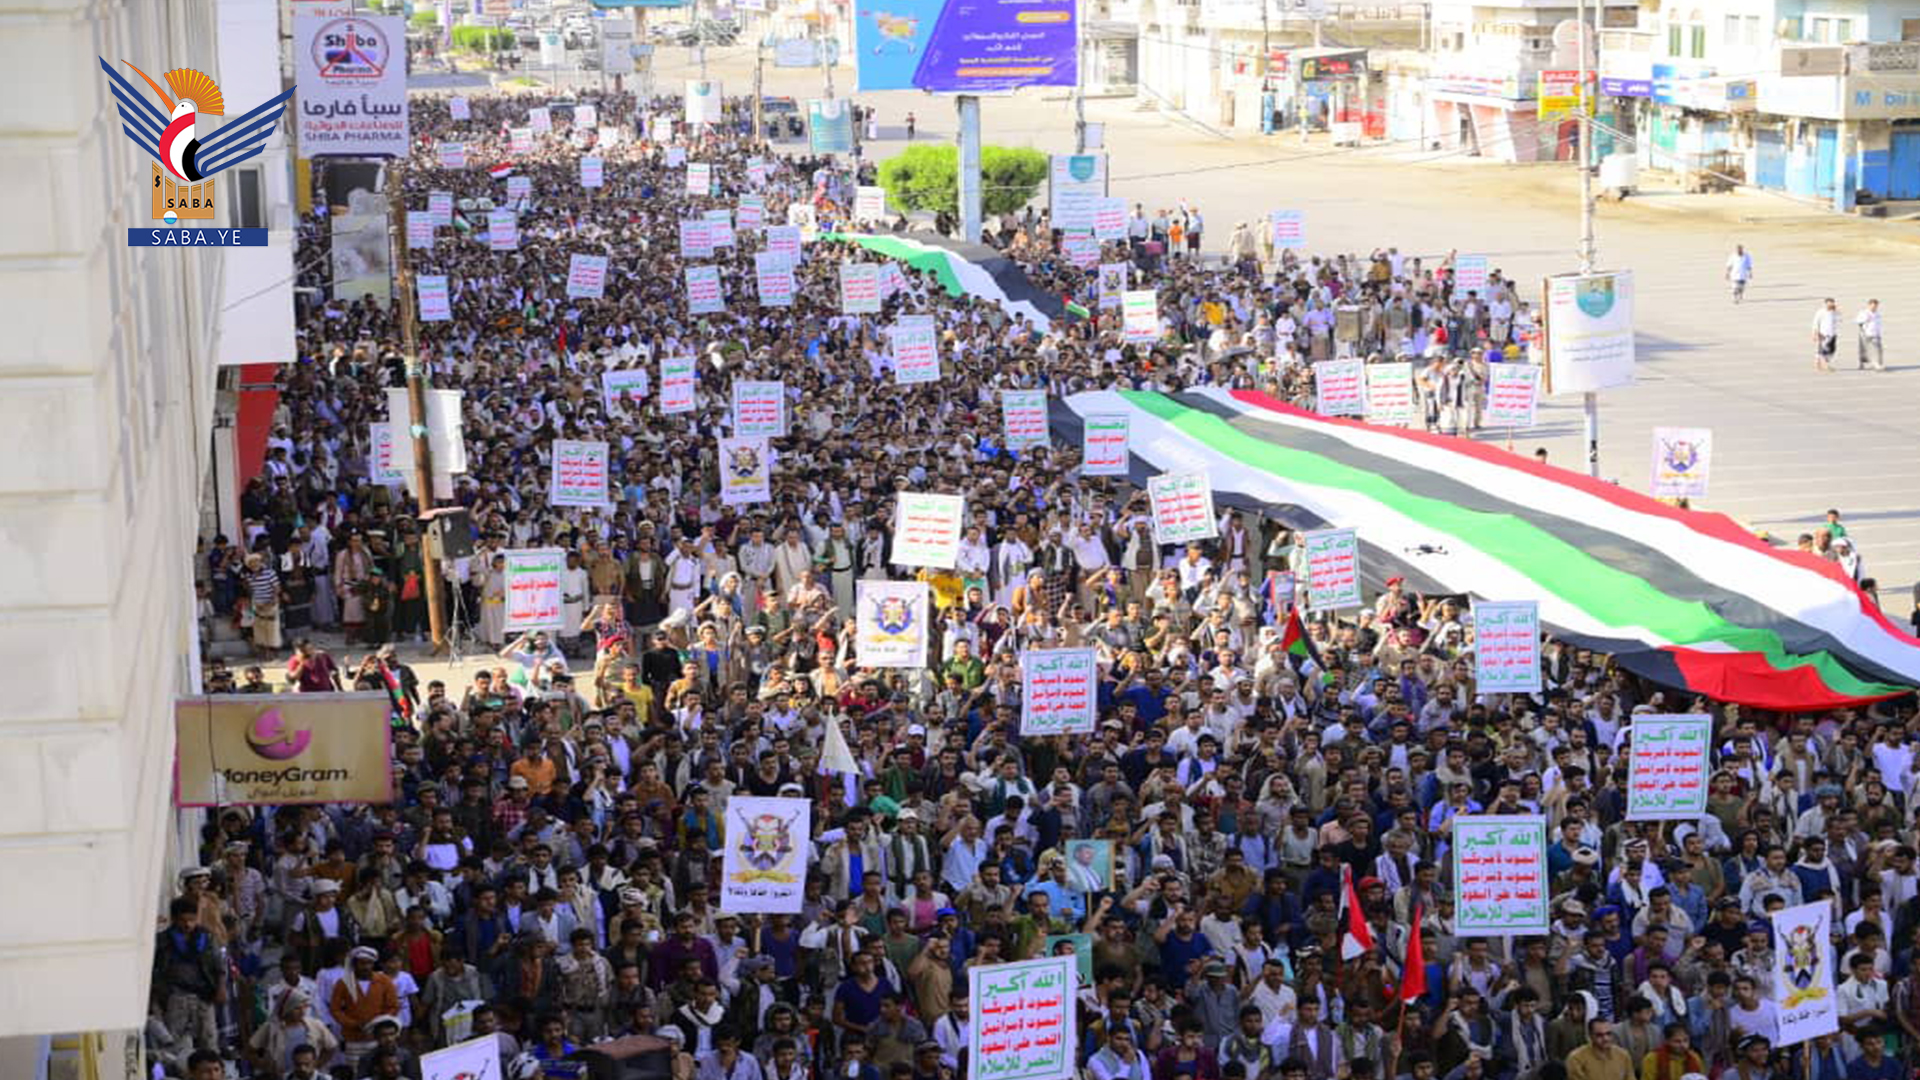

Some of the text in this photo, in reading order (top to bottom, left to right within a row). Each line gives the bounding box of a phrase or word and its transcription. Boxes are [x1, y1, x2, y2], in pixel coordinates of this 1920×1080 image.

[303, 94, 402, 119] سبأ فارما
[344, 131, 402, 141] PHARMA
